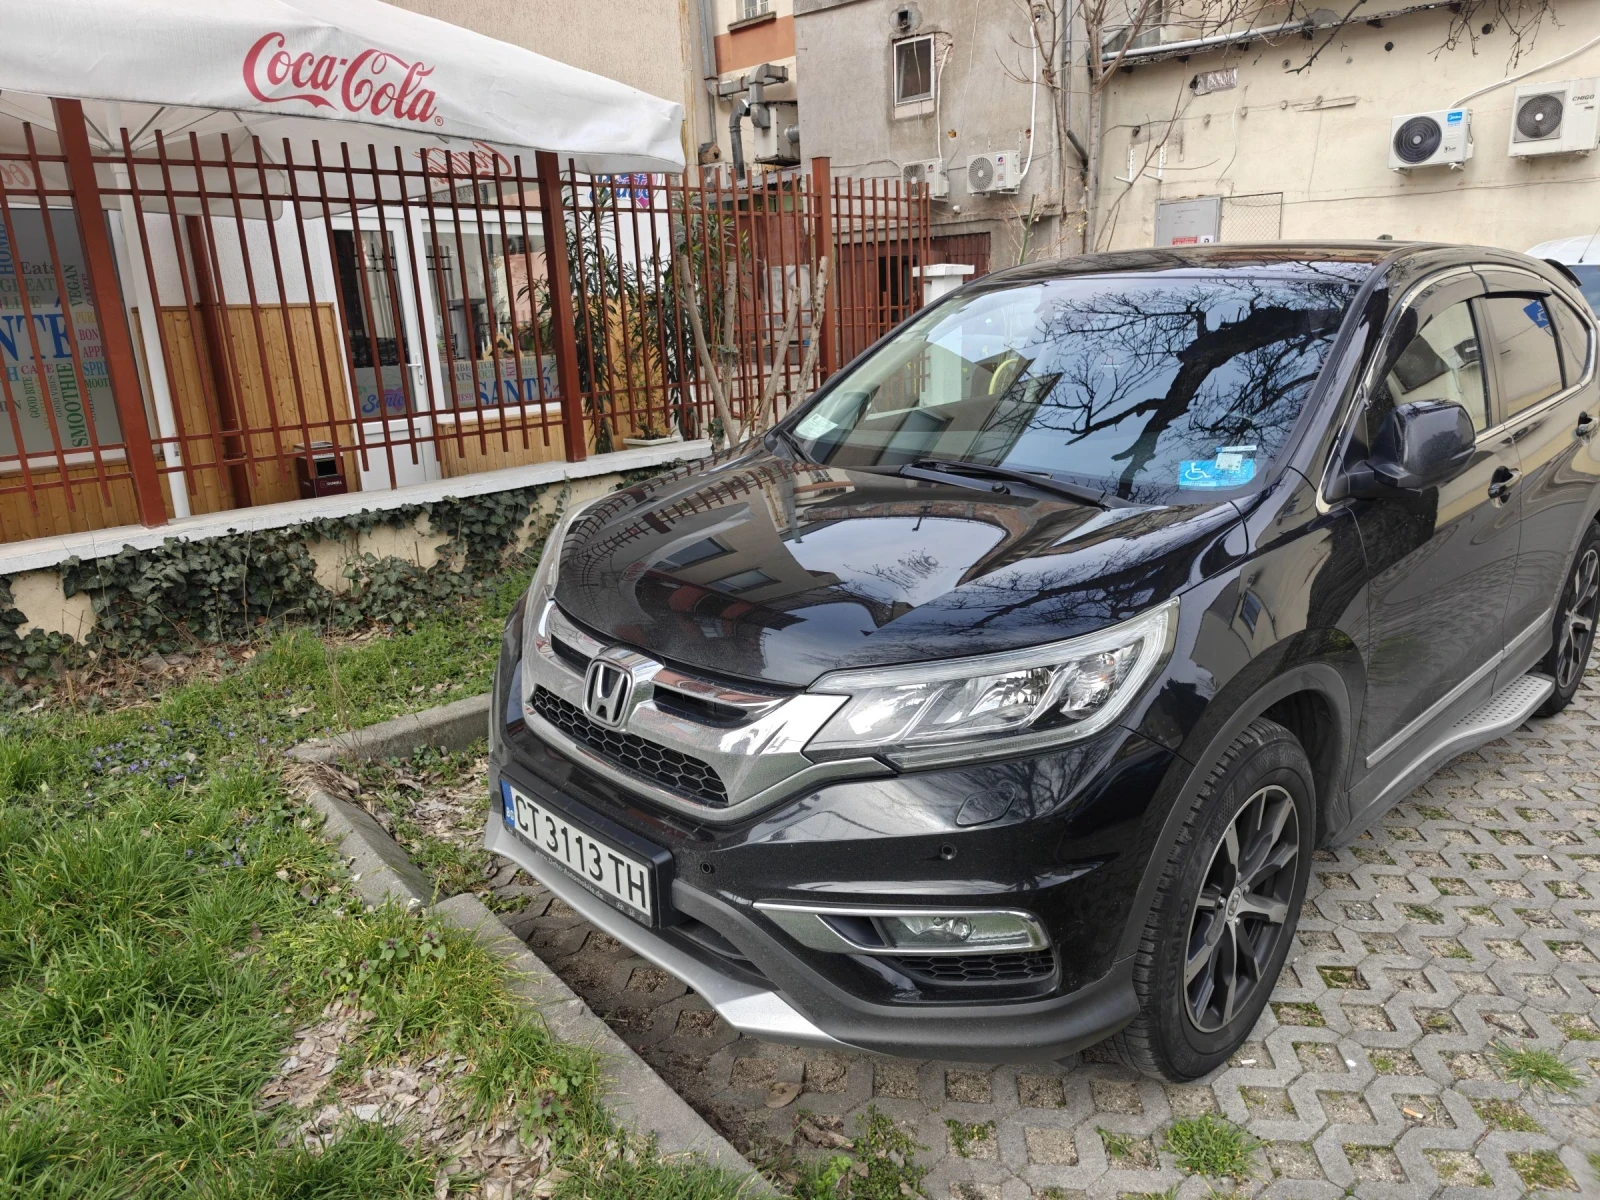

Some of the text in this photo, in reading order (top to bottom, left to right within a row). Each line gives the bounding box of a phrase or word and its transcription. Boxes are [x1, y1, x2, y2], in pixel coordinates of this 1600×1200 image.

[243, 31, 437, 123] Coca-Cola
[3, 295, 42, 310] LIE
[63, 264, 84, 307] VEGAN
[21, 364, 54, 375] CAE
[55, 362, 89, 448] SMOOTHIE
[515, 794, 540, 841] CT
[545, 815, 605, 882] 3113
[607, 852, 648, 909] TH
